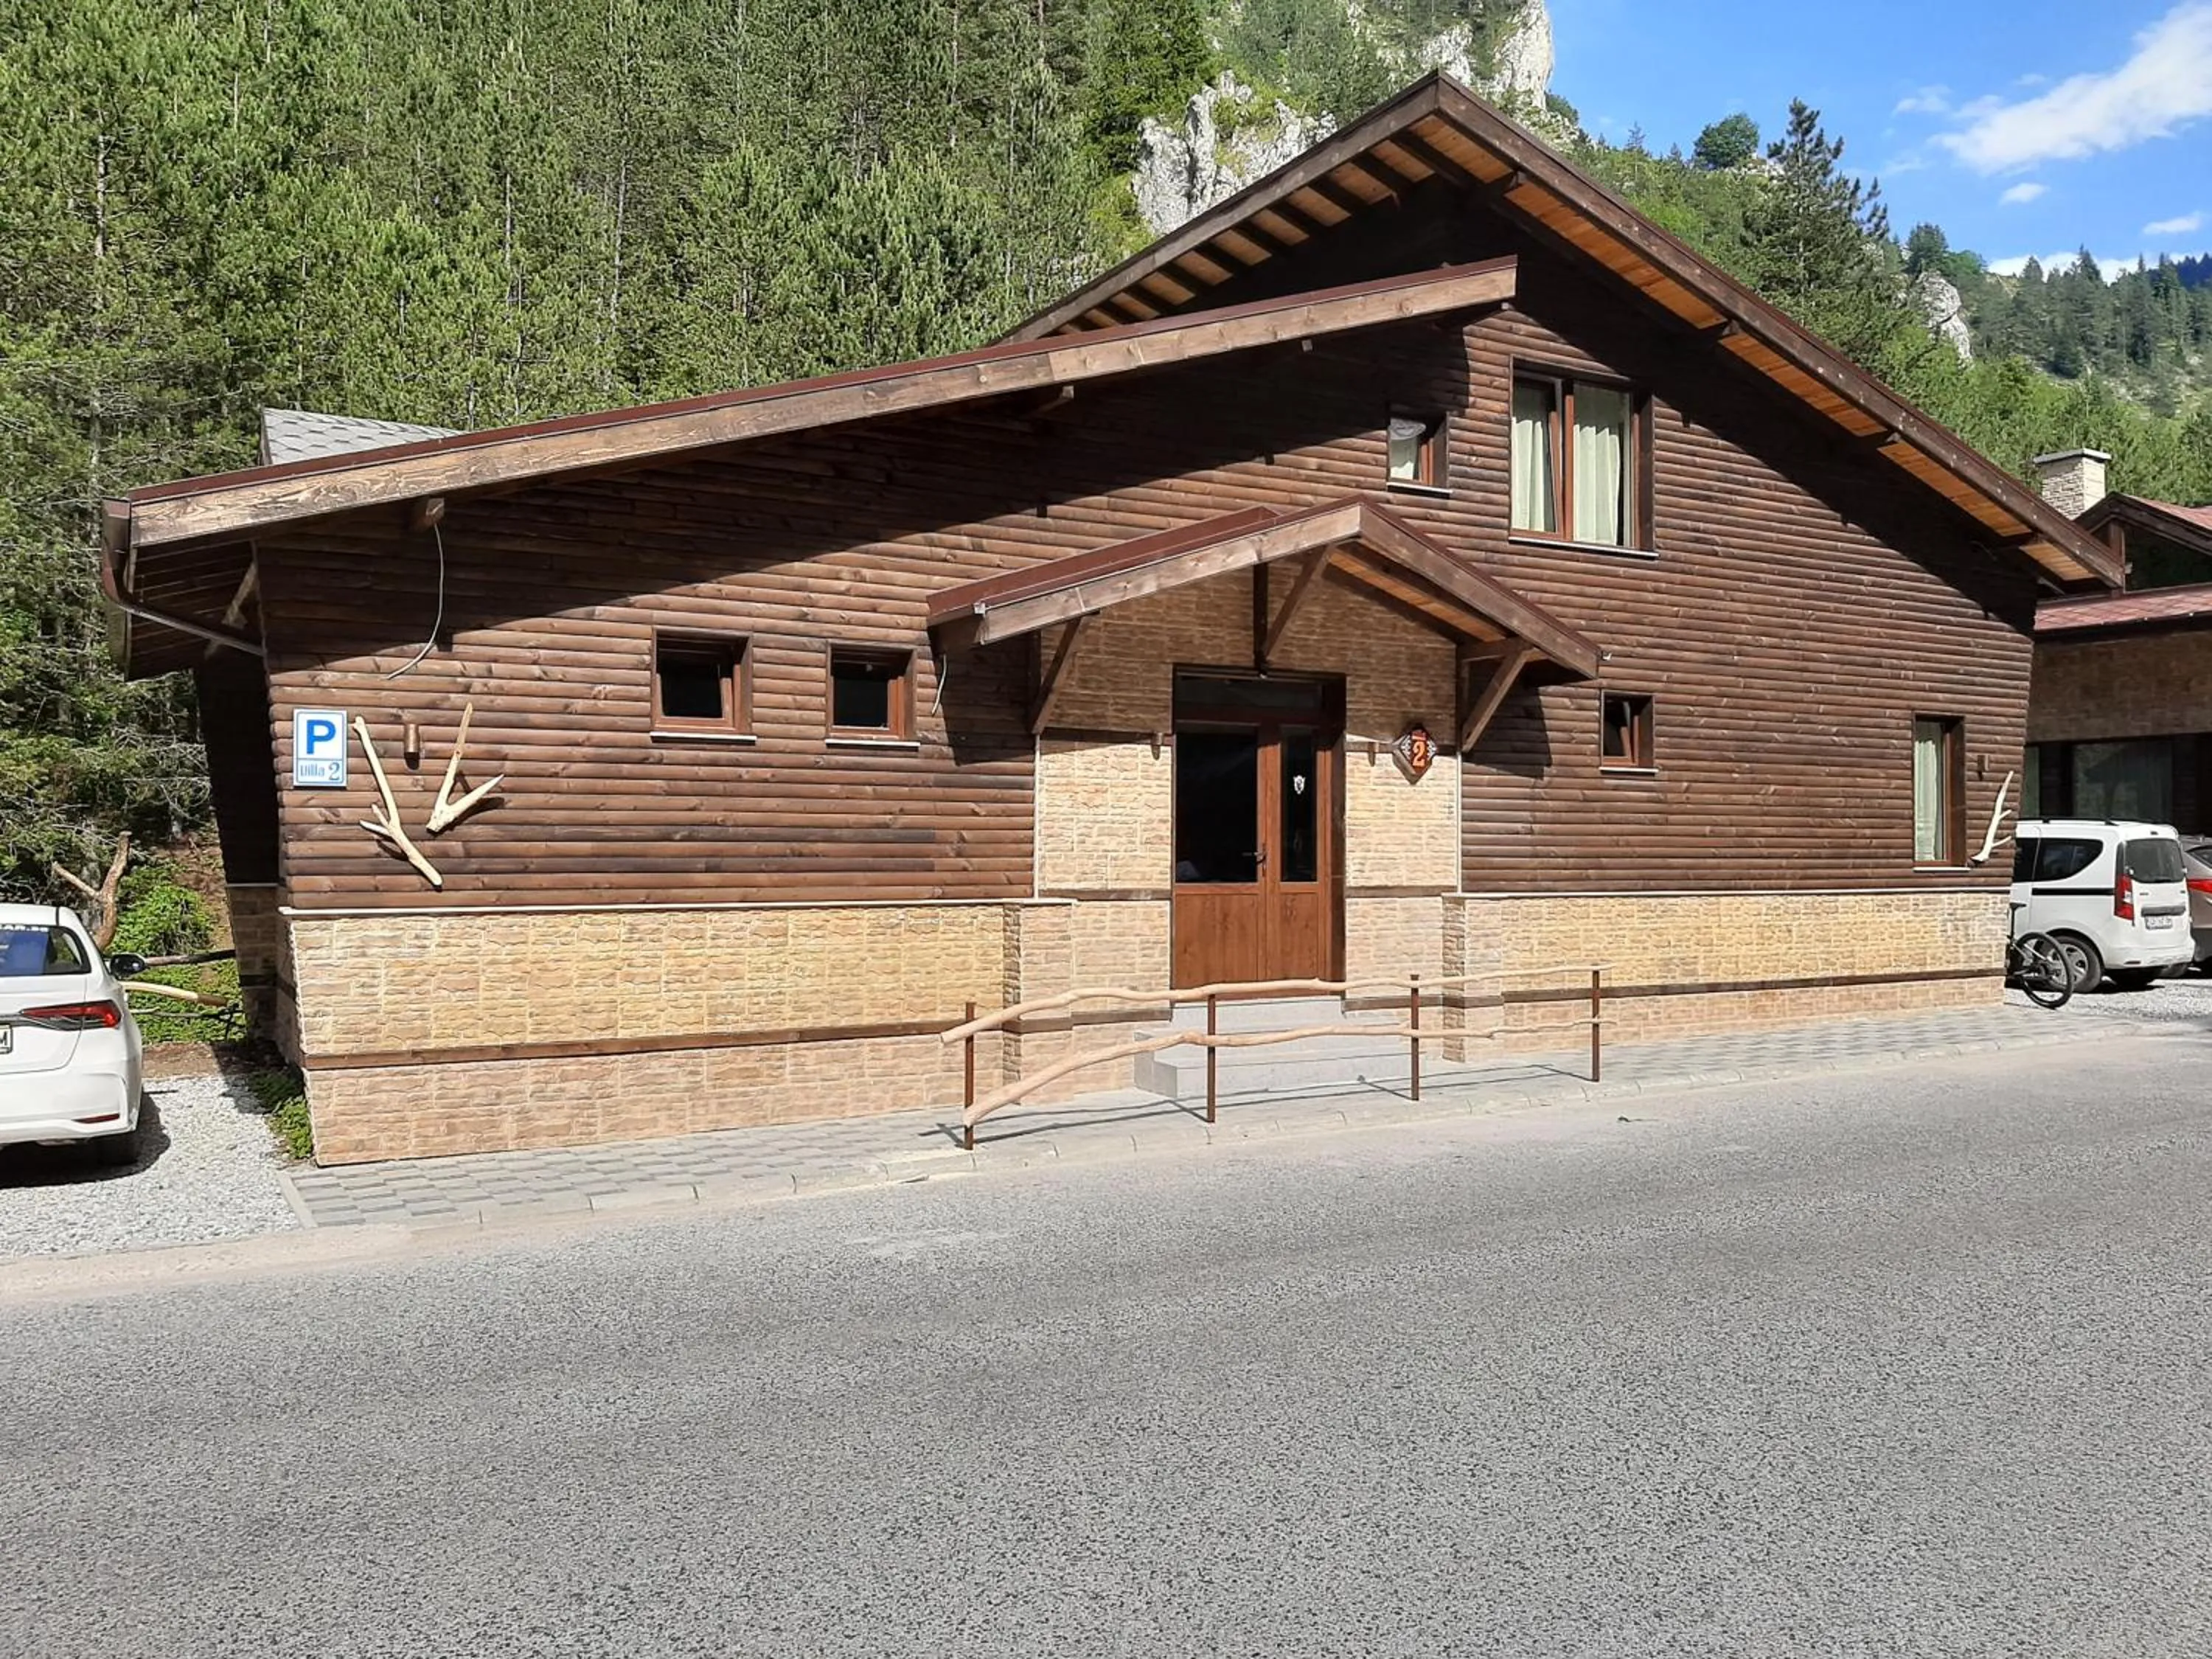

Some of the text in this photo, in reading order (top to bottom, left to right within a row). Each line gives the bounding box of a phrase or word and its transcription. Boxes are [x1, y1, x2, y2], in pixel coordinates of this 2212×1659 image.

[306, 719, 336, 755] P
[1413, 741, 1425, 766] 2
[329, 762, 341, 781] 2
